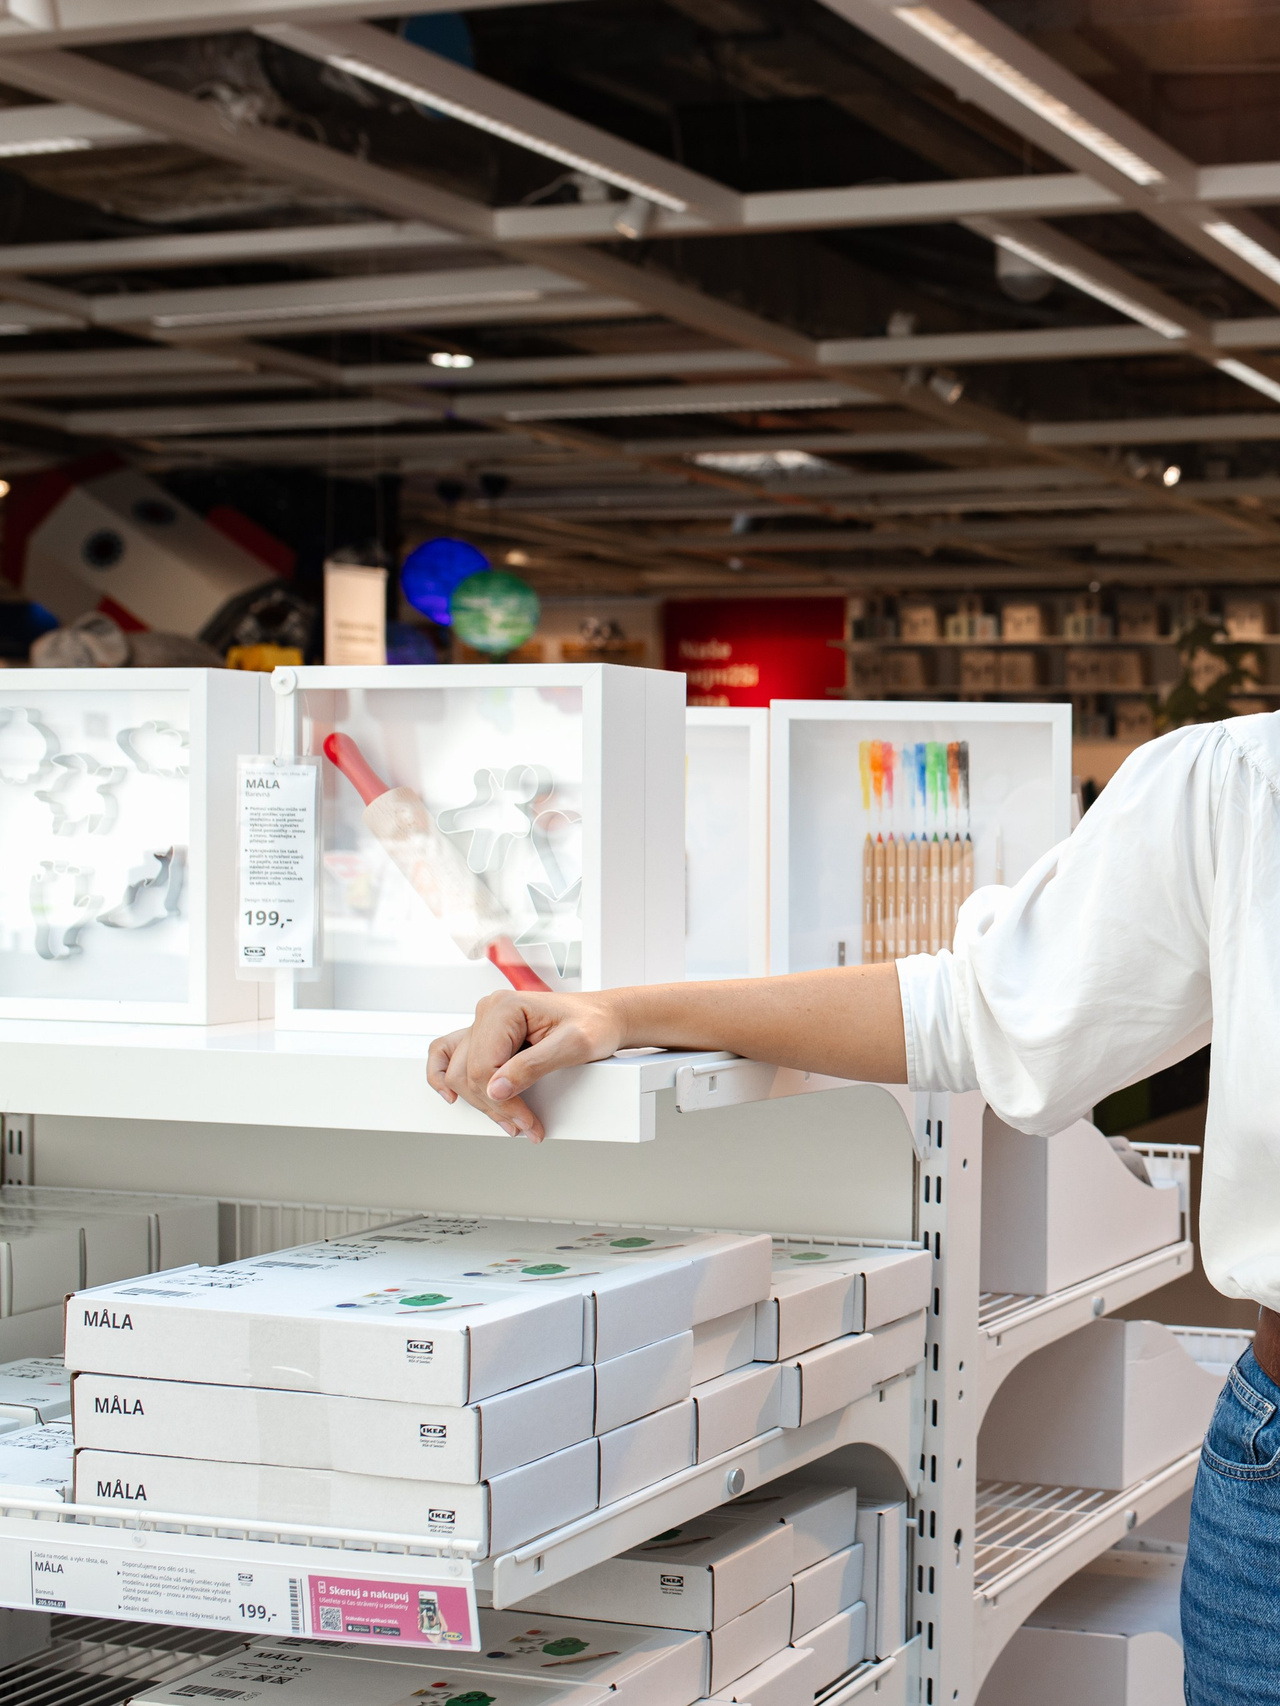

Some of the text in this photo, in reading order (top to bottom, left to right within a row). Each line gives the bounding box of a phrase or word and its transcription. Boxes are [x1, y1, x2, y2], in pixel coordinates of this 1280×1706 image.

[245, 777, 280, 788] MÅLA
[244, 910, 292, 928] 199,-
[84, 1309, 133, 1330] MÅLA
[95, 1395, 144, 1415] MÅLA
[97, 1479, 147, 1501] MÅLA
[35, 1561, 64, 1574] MÅLA
[329, 1585, 361, 1599] Skenuj
[370, 1590, 409, 1603] nakupuj
[238, 1603, 277, 1622] 199,-
[253, 1652, 304, 1662] MÅLA
